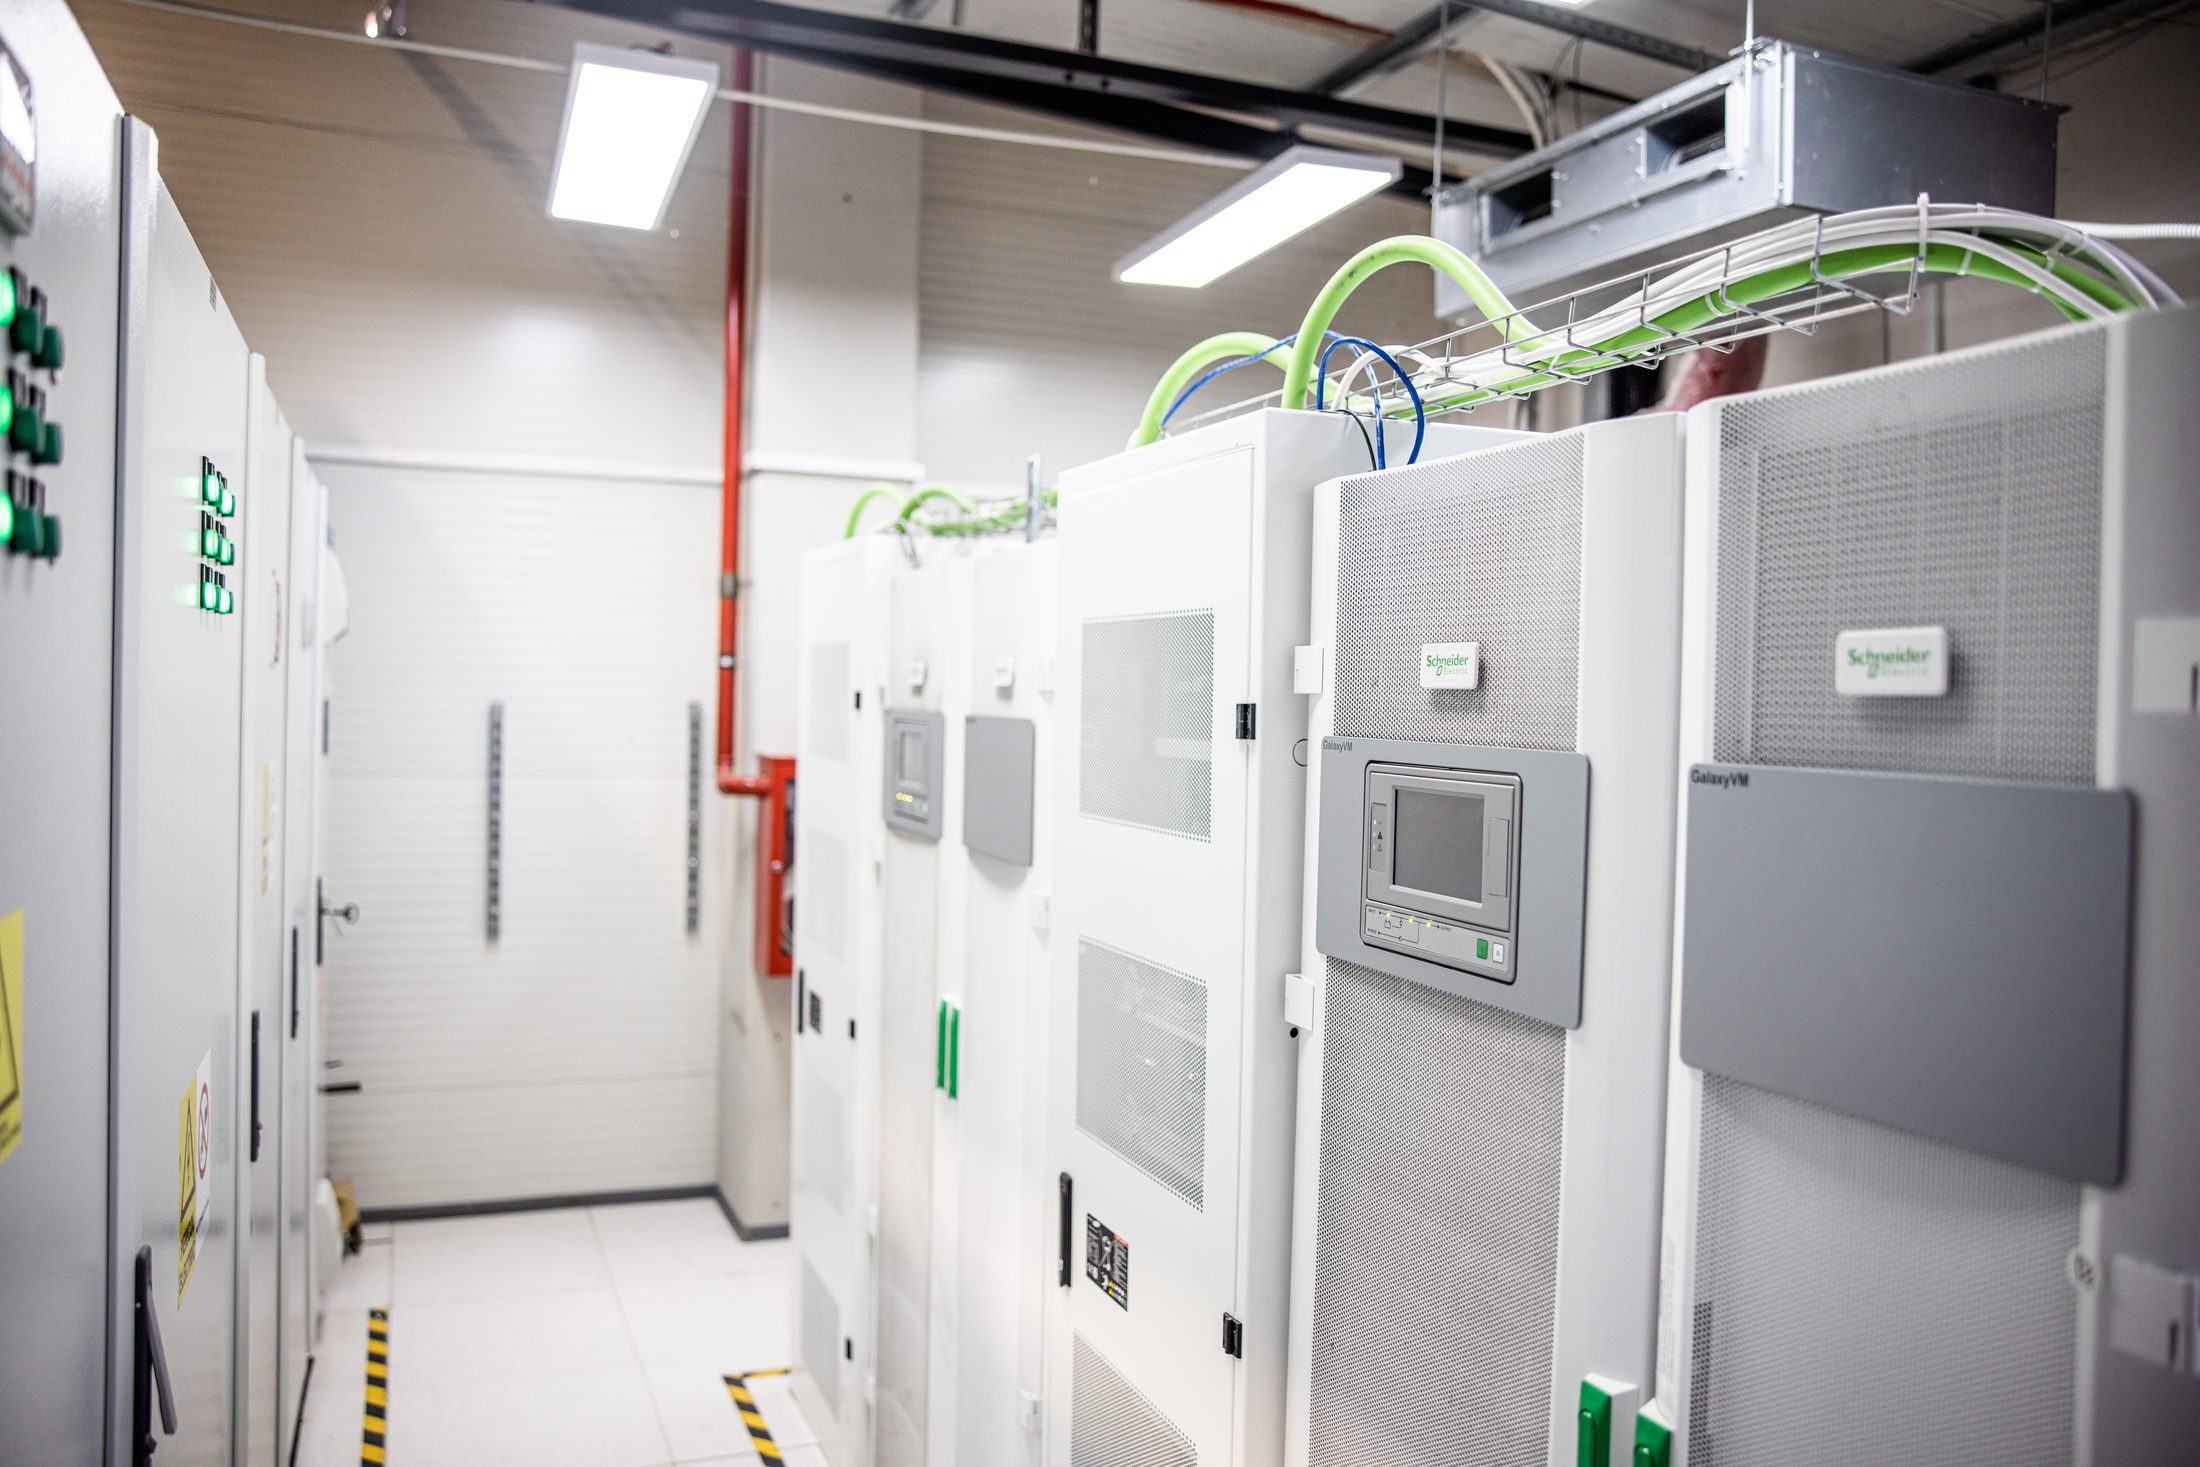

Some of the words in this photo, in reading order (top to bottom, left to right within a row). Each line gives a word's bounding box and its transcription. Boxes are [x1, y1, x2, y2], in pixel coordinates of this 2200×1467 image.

[1426, 653, 1469, 671] Schneider
[1847, 646, 1930, 672] Schneider
[1443, 666, 1468, 675] Electric
